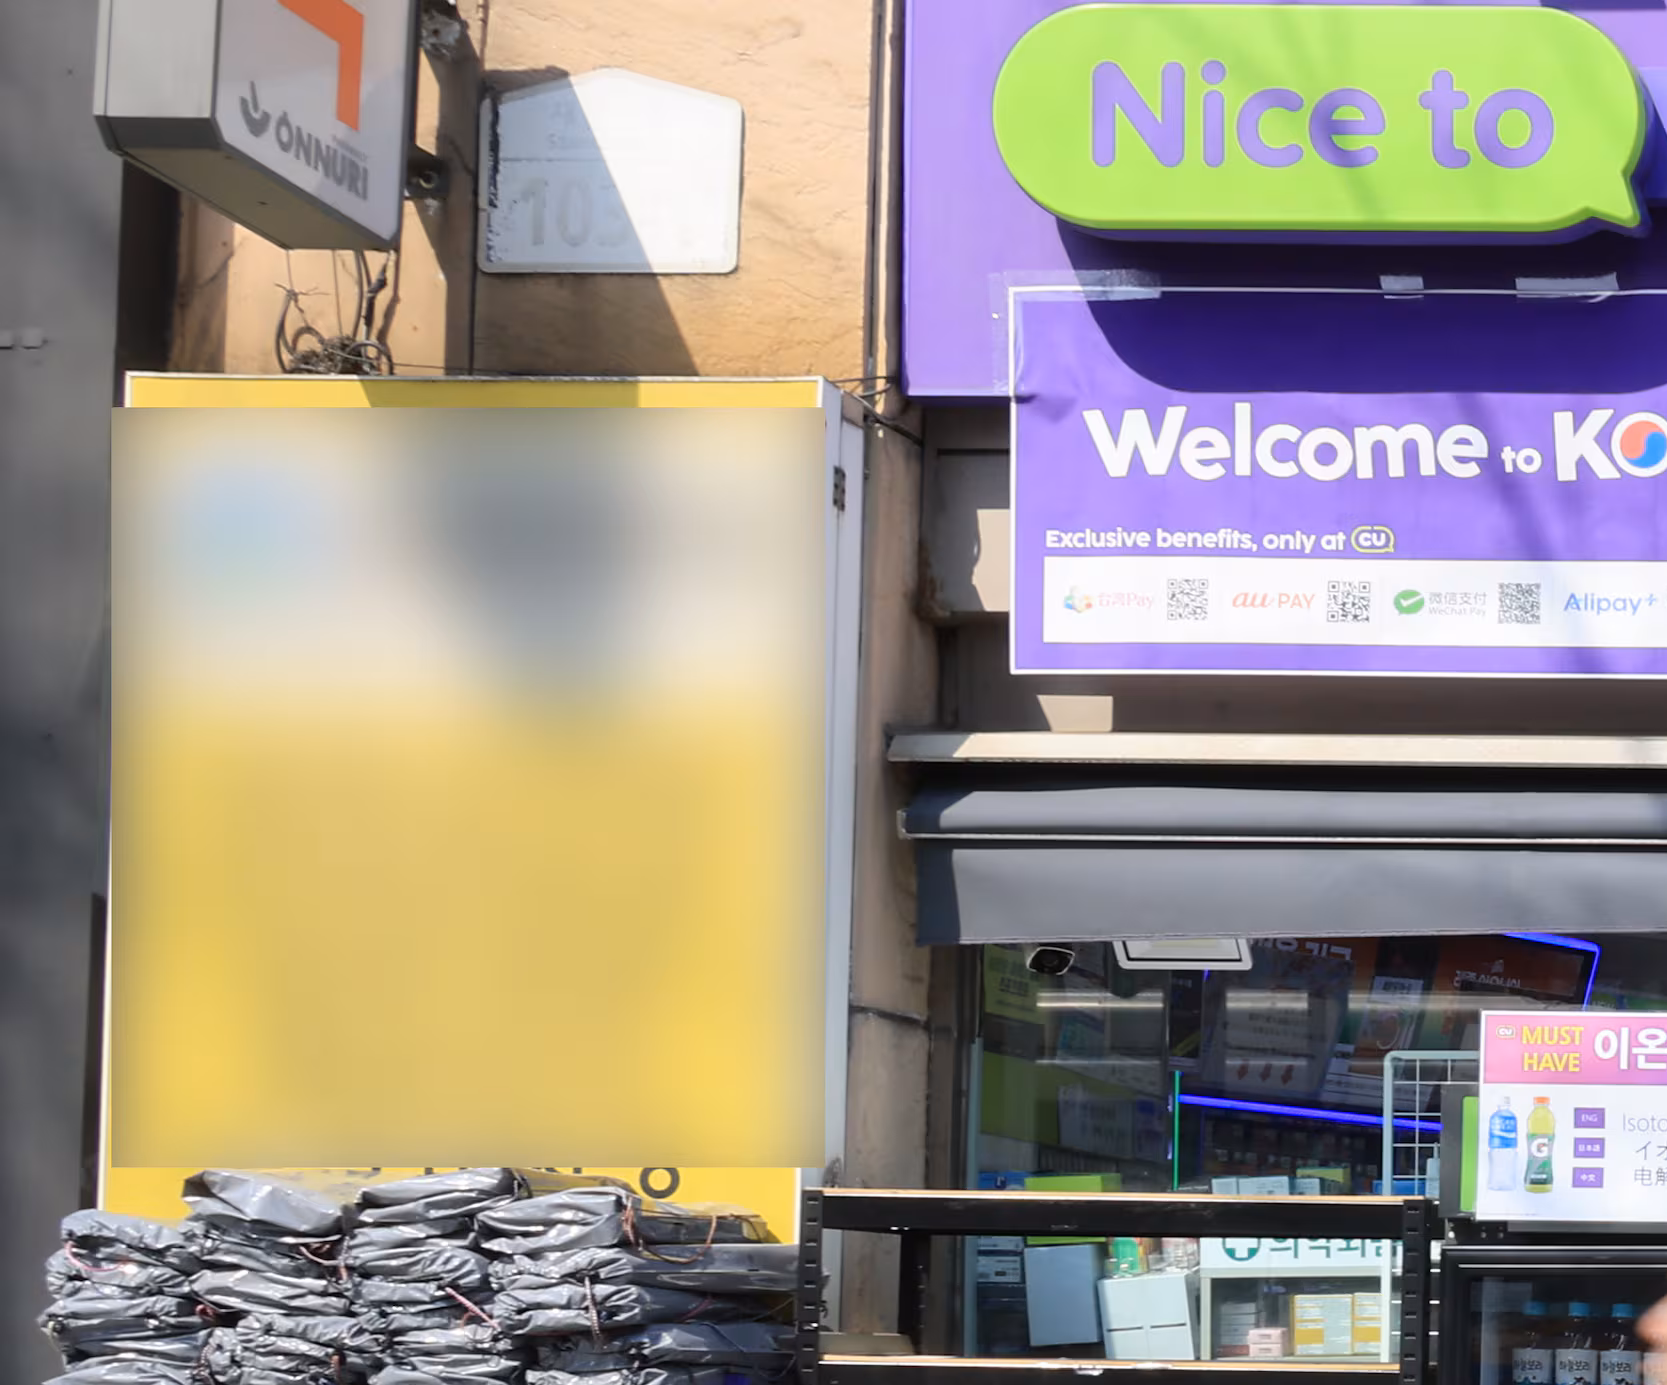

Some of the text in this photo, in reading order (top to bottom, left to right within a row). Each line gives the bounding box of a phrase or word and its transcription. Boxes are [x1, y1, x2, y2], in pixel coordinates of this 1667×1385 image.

[1092, 60, 1554, 171] Nice to
[1083, 403, 1489, 480] Welcome
[1501, 443, 1542, 476] to
[1045, 528, 1152, 550] Exclusive
[1156, 528, 1258, 554] benefits,
[1263, 531, 1317, 554] only
[1321, 533, 1346, 551] at
[1277, 592, 1316, 610] PAY
[1429, 607, 1487, 618] WeChat Pay
[1522, 1026, 1584, 1045] MUST
[1523, 1053, 1580, 1072] HAVE
